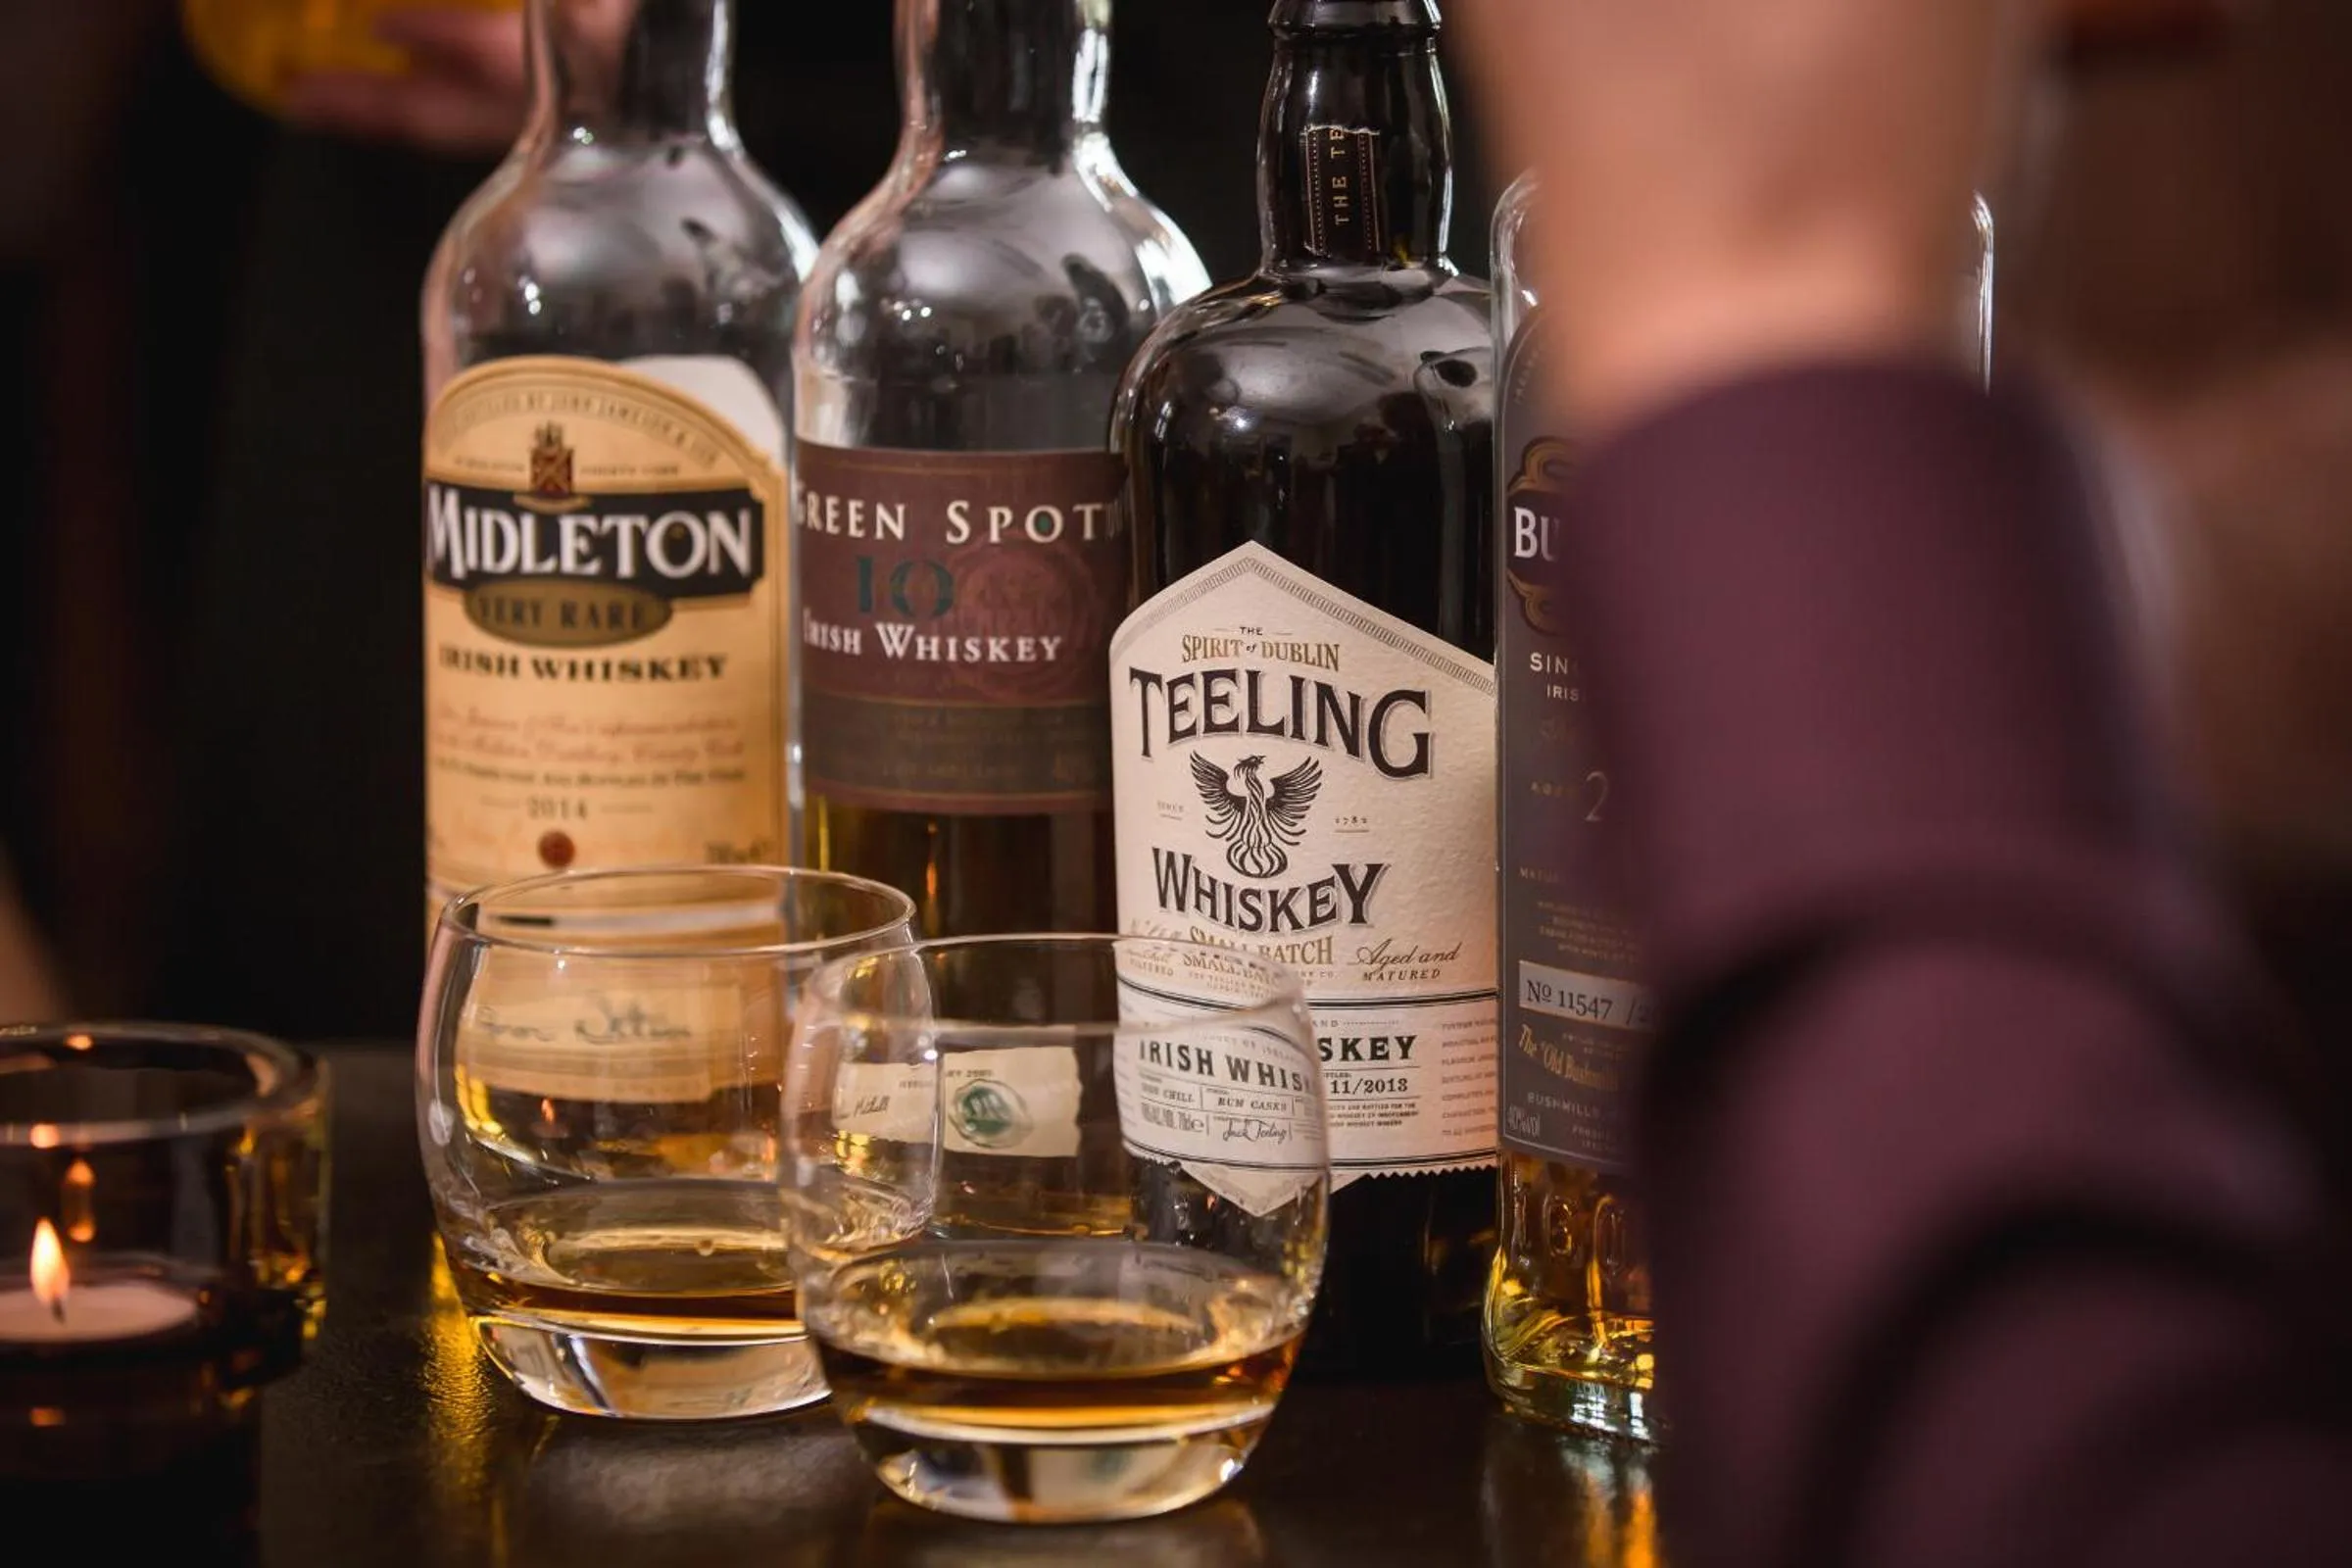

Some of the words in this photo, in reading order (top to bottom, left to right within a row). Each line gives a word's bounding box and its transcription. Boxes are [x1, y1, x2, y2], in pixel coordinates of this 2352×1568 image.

[1332, 175, 1349, 225] THE
[428, 485, 752, 579] MIDLETON
[947, 500, 1103, 544] SPOT
[856, 555, 956, 619] 10
[803, 607, 862, 656] IRISH
[875, 621, 1062, 663] WHISKEY
[1239, 626, 1263, 636] THE
[439, 647, 521, 677] IRISH
[531, 654, 728, 683] WHISKEY
[1181, 633, 1244, 663] SPIRIT
[1261, 640, 1340, 672] DUBLIN
[1128, 666, 1432, 780] TEELING
[1152, 847, 1390, 933] WHISKEY
[1350, 938, 1416, 970] Aged
[1419, 941, 1464, 964] and
[1362, 967, 1442, 983] MATURED
[1557, 989, 1613, 1021] 11547
[1139, 1040, 1214, 1077] IRISH
[1330, 1077, 1408, 1096] 11/2013
